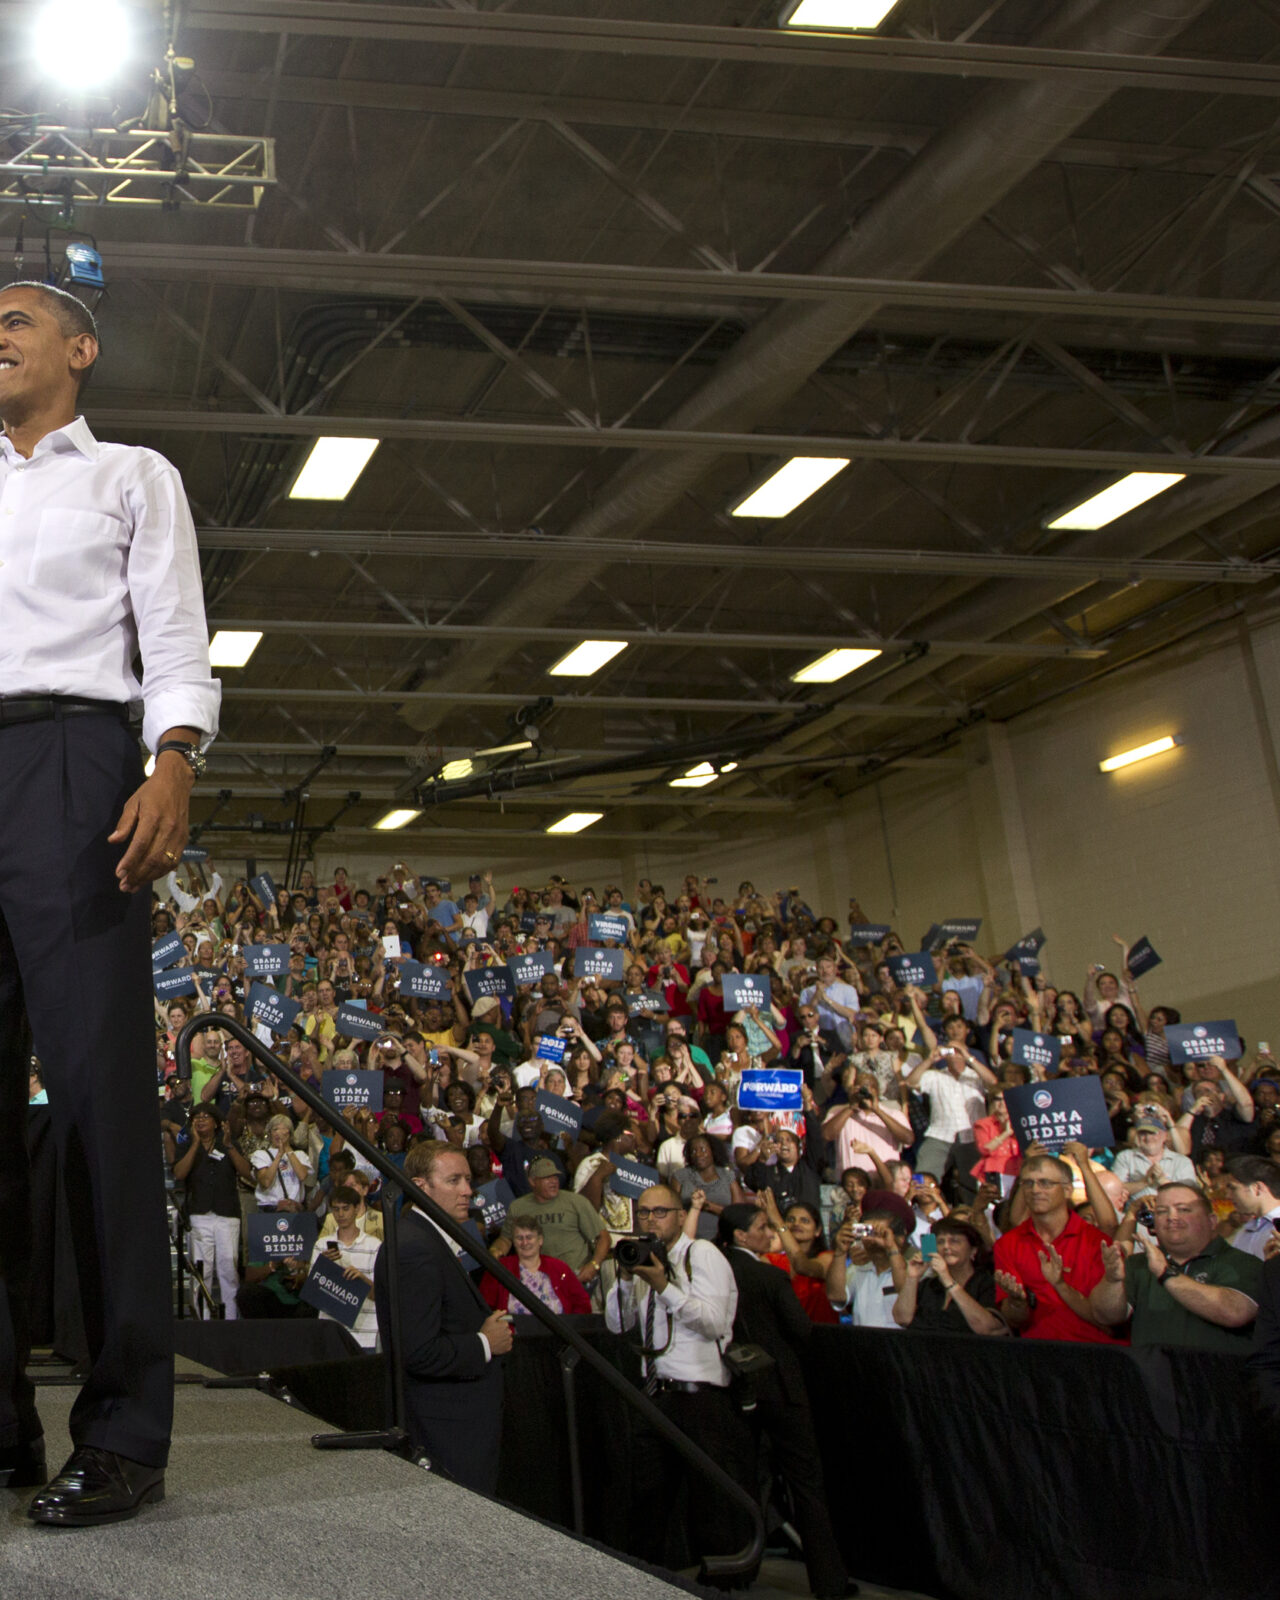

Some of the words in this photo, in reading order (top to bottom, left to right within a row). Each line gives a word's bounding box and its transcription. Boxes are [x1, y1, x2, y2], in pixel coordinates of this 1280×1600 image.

[152, 940, 179, 960] ORWARD
[516, 964, 545, 974] OBAMA
[584, 960, 613, 968] OBAMA
[518, 971, 544, 979] BIDEN
[585, 966, 612, 974] BIDEN
[156, 975, 192, 989] FORWARD
[411, 977, 442, 987] OBAMA
[478, 979, 506, 988] OBAMA
[411, 984, 440, 993] BIDEN
[480, 985, 506, 993] BIDEN
[734, 989, 764, 997] OBAMA
[254, 1000, 284, 1019] OBAMA
[252, 1007, 280, 1024] BIDEN
[341, 1013, 382, 1030] FORWARD
[541, 1037, 565, 1050] 2012
[1182, 1037, 1225, 1048] OBAMA
[1023, 1044, 1052, 1057] OBAMA
[1185, 1045, 1225, 1055] BIDEN
[1023, 1051, 1051, 1063] BIDEN
[333, 1087, 370, 1095] OBAMA
[743, 1082, 798, 1093] FORWARD
[334, 1095, 368, 1103] BIDEN
[540, 1104, 578, 1128] FORWARD
[1021, 1110, 1082, 1127] OBAMA
[1025, 1124, 1082, 1141] BIDEN
[616, 1167, 655, 1187] ORWARD
[482, 1202, 504, 1216] AMA
[484, 1210, 506, 1224] DEN
[537, 1213, 565, 1224] RMY
[263, 1235, 304, 1243] OBAMA
[265, 1244, 304, 1252] BIDEN
[313, 1271, 359, 1306] FORWARD
